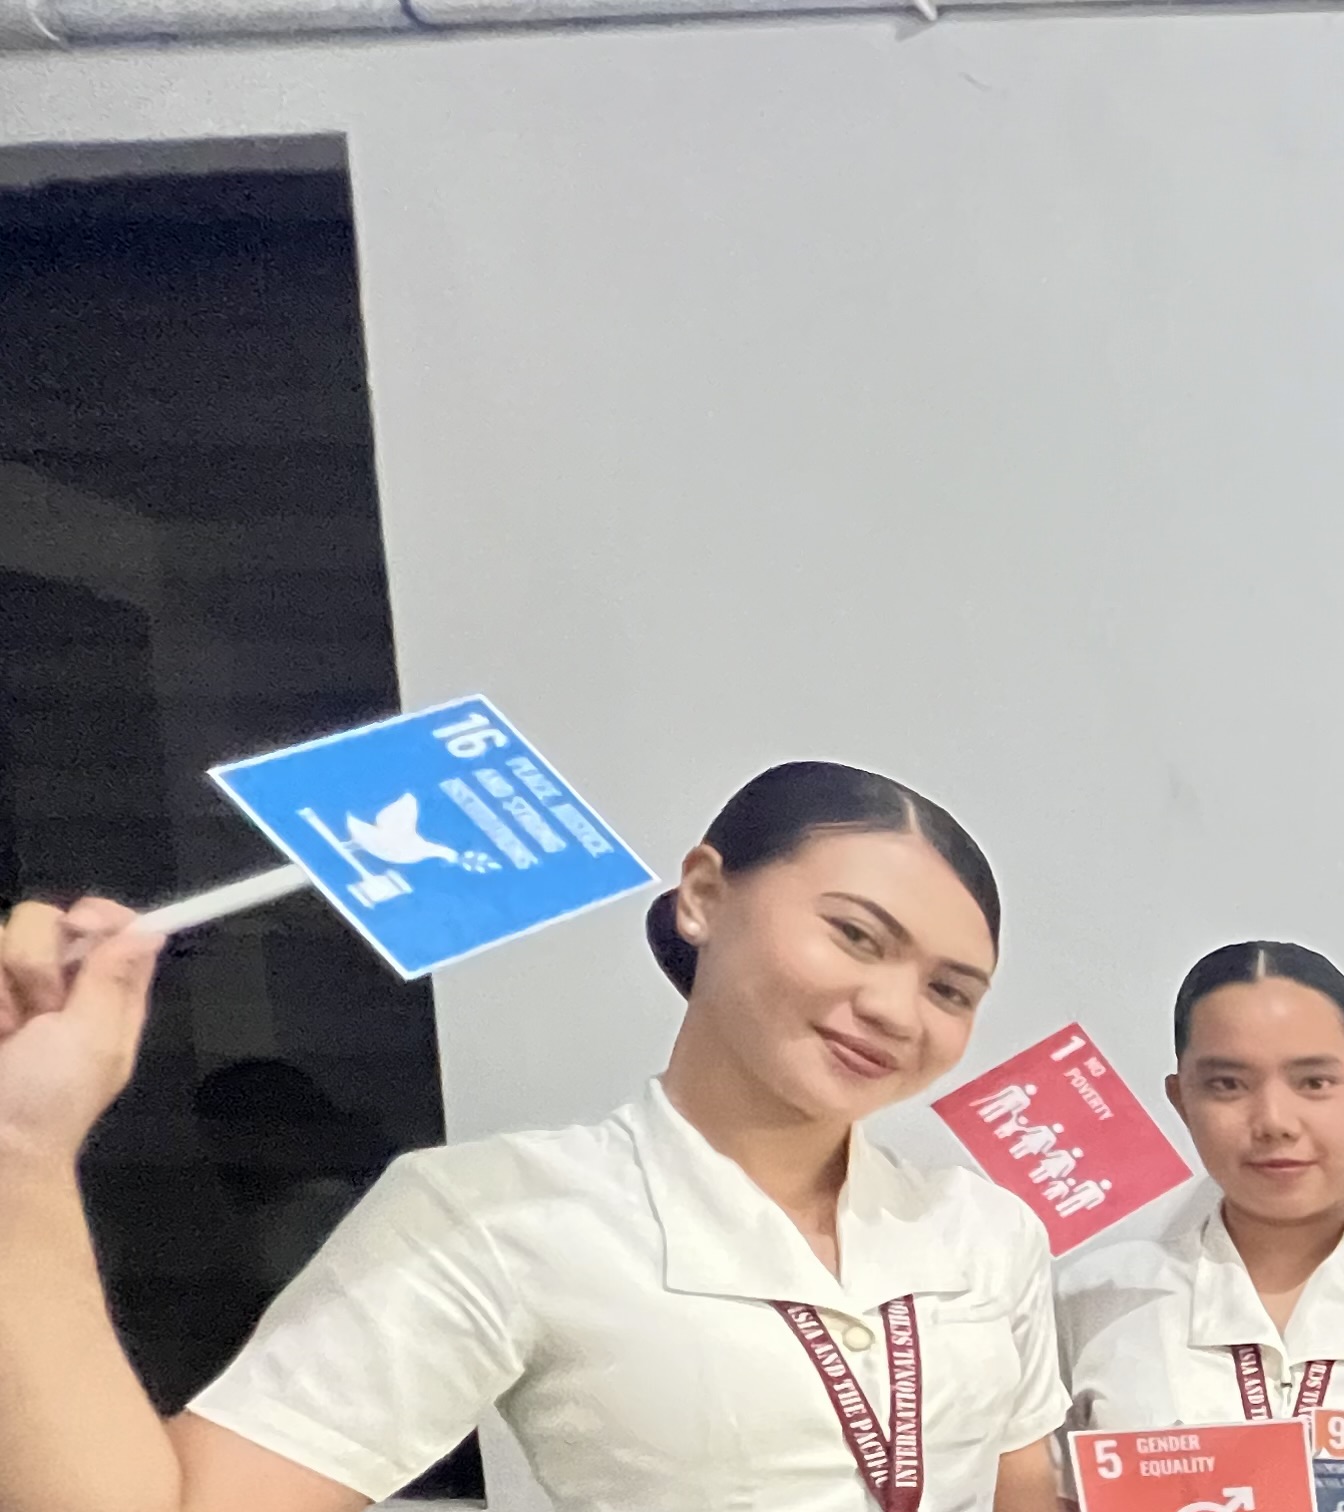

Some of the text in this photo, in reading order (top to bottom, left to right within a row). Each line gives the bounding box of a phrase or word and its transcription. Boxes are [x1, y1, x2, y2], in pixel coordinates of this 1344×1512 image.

[432, 712, 508, 758] 16
[1050, 1036, 1086, 1061] 1
[1084, 1057, 1106, 1077] NO
[1064, 1068, 1114, 1120] POVERTY
[811, 1343, 847, 1377] AND
[833, 1378, 867, 1418] THE
[892, 1349, 918, 1488] INTERNATIONAL
[1094, 1440, 1123, 1479] 5
[1136, 1435, 1200, 1454] GENDER
[1140, 1456, 1215, 1477] EQUALITY
